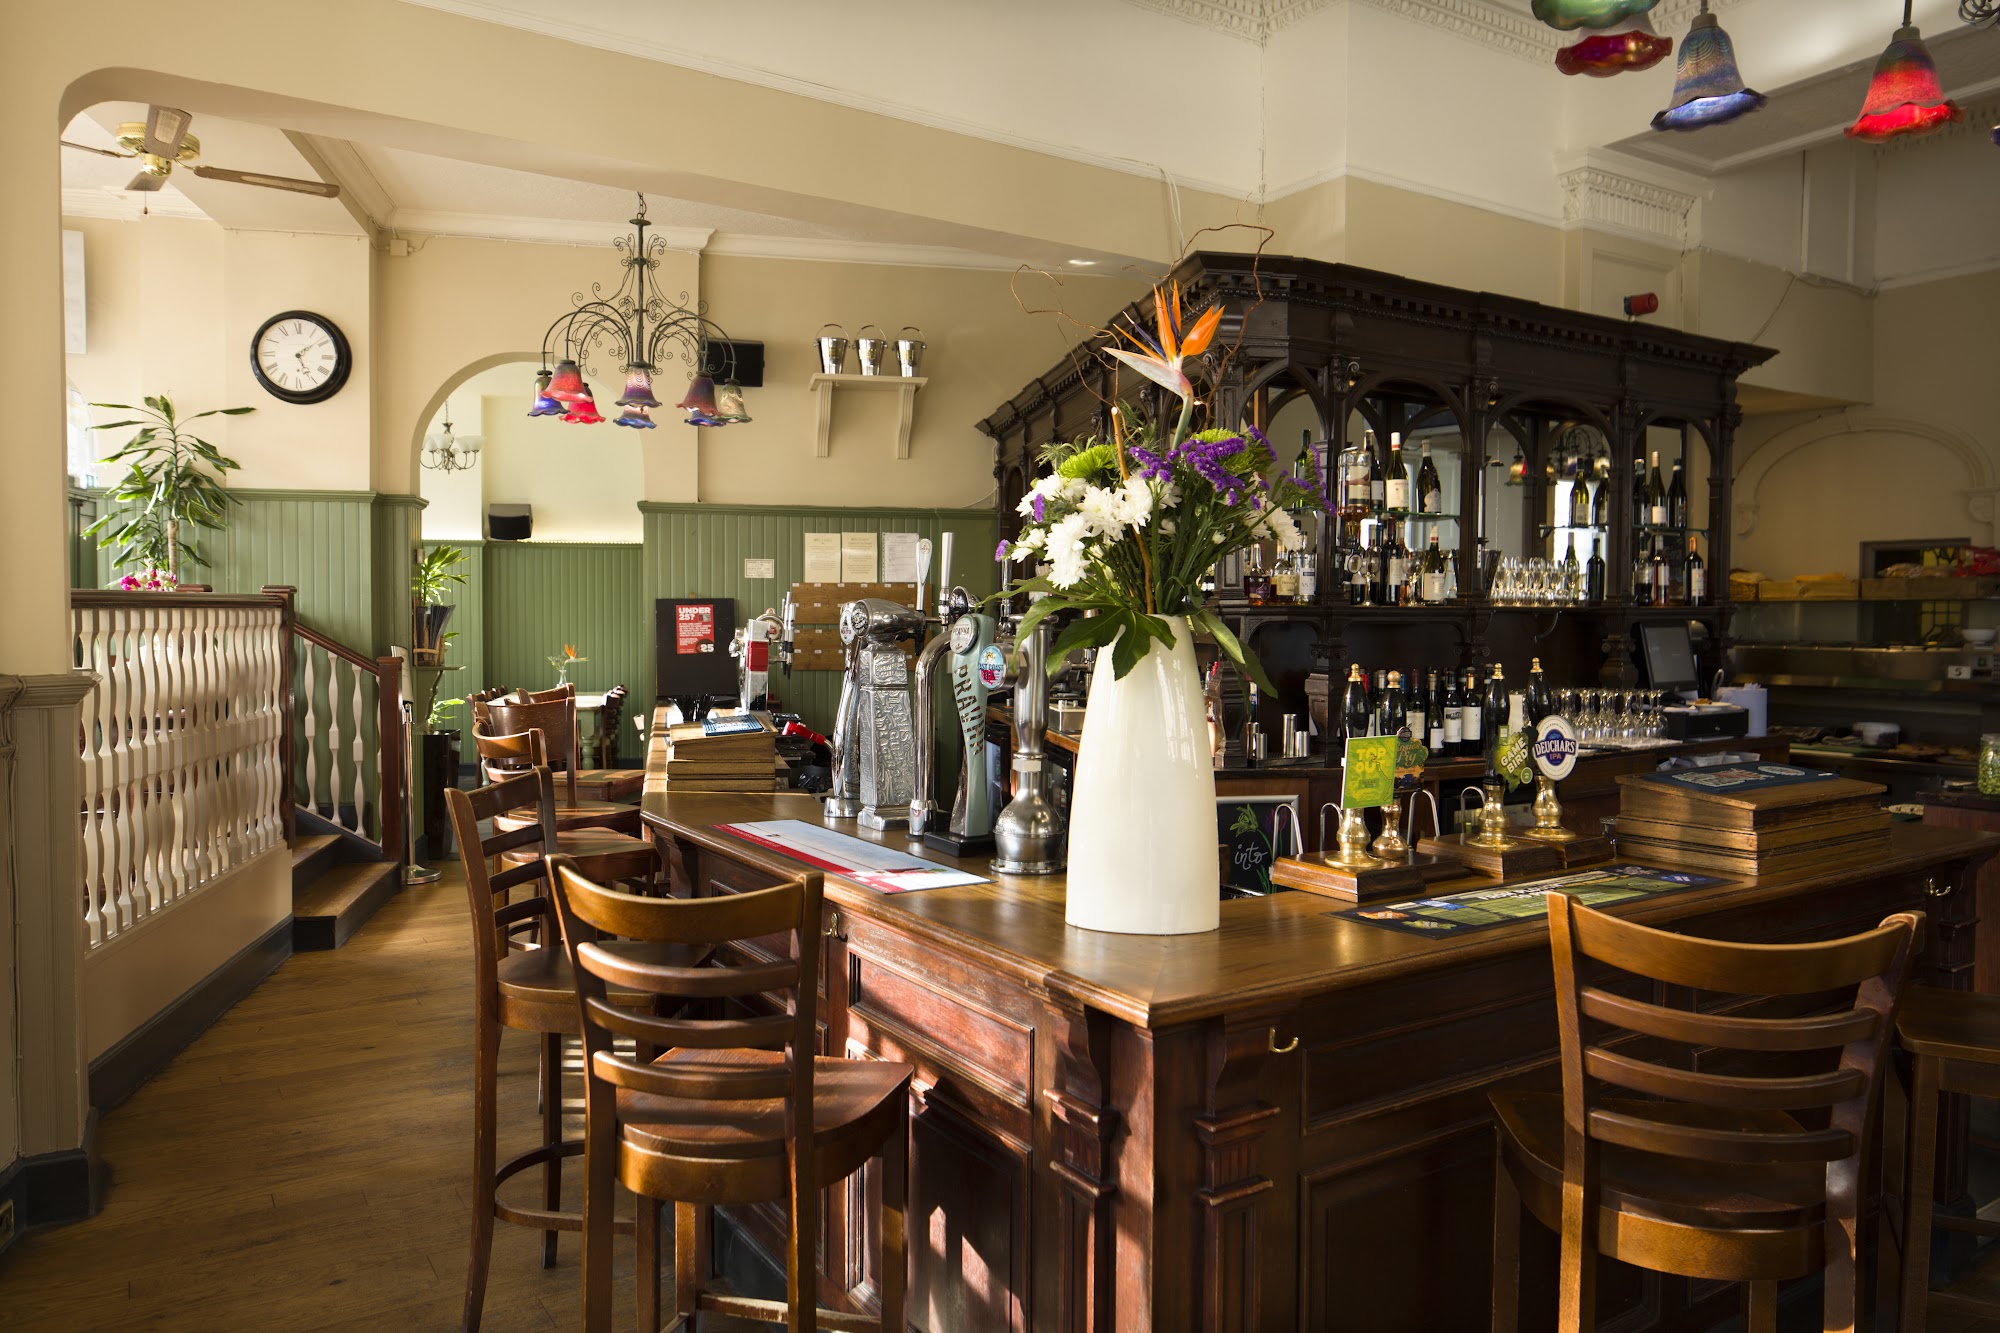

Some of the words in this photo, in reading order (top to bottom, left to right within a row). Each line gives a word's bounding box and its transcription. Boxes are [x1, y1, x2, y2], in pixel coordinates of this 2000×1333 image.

[678, 613, 696, 621] 25?
[700, 643, 714, 653] 25
[988, 663, 1004, 671] COAST
[1954, 667, 1963, 676] 5
[954, 663, 985, 756] PRAVHA
[1356, 747, 1387, 761] TOP
[1501, 737, 1526, 766] GAME
[1535, 740, 1575, 755] DEUCHARS
[1355, 760, 1386, 773] OUT
[1506, 748, 1528, 774] BIRD
[1234, 841, 1268, 870] into
